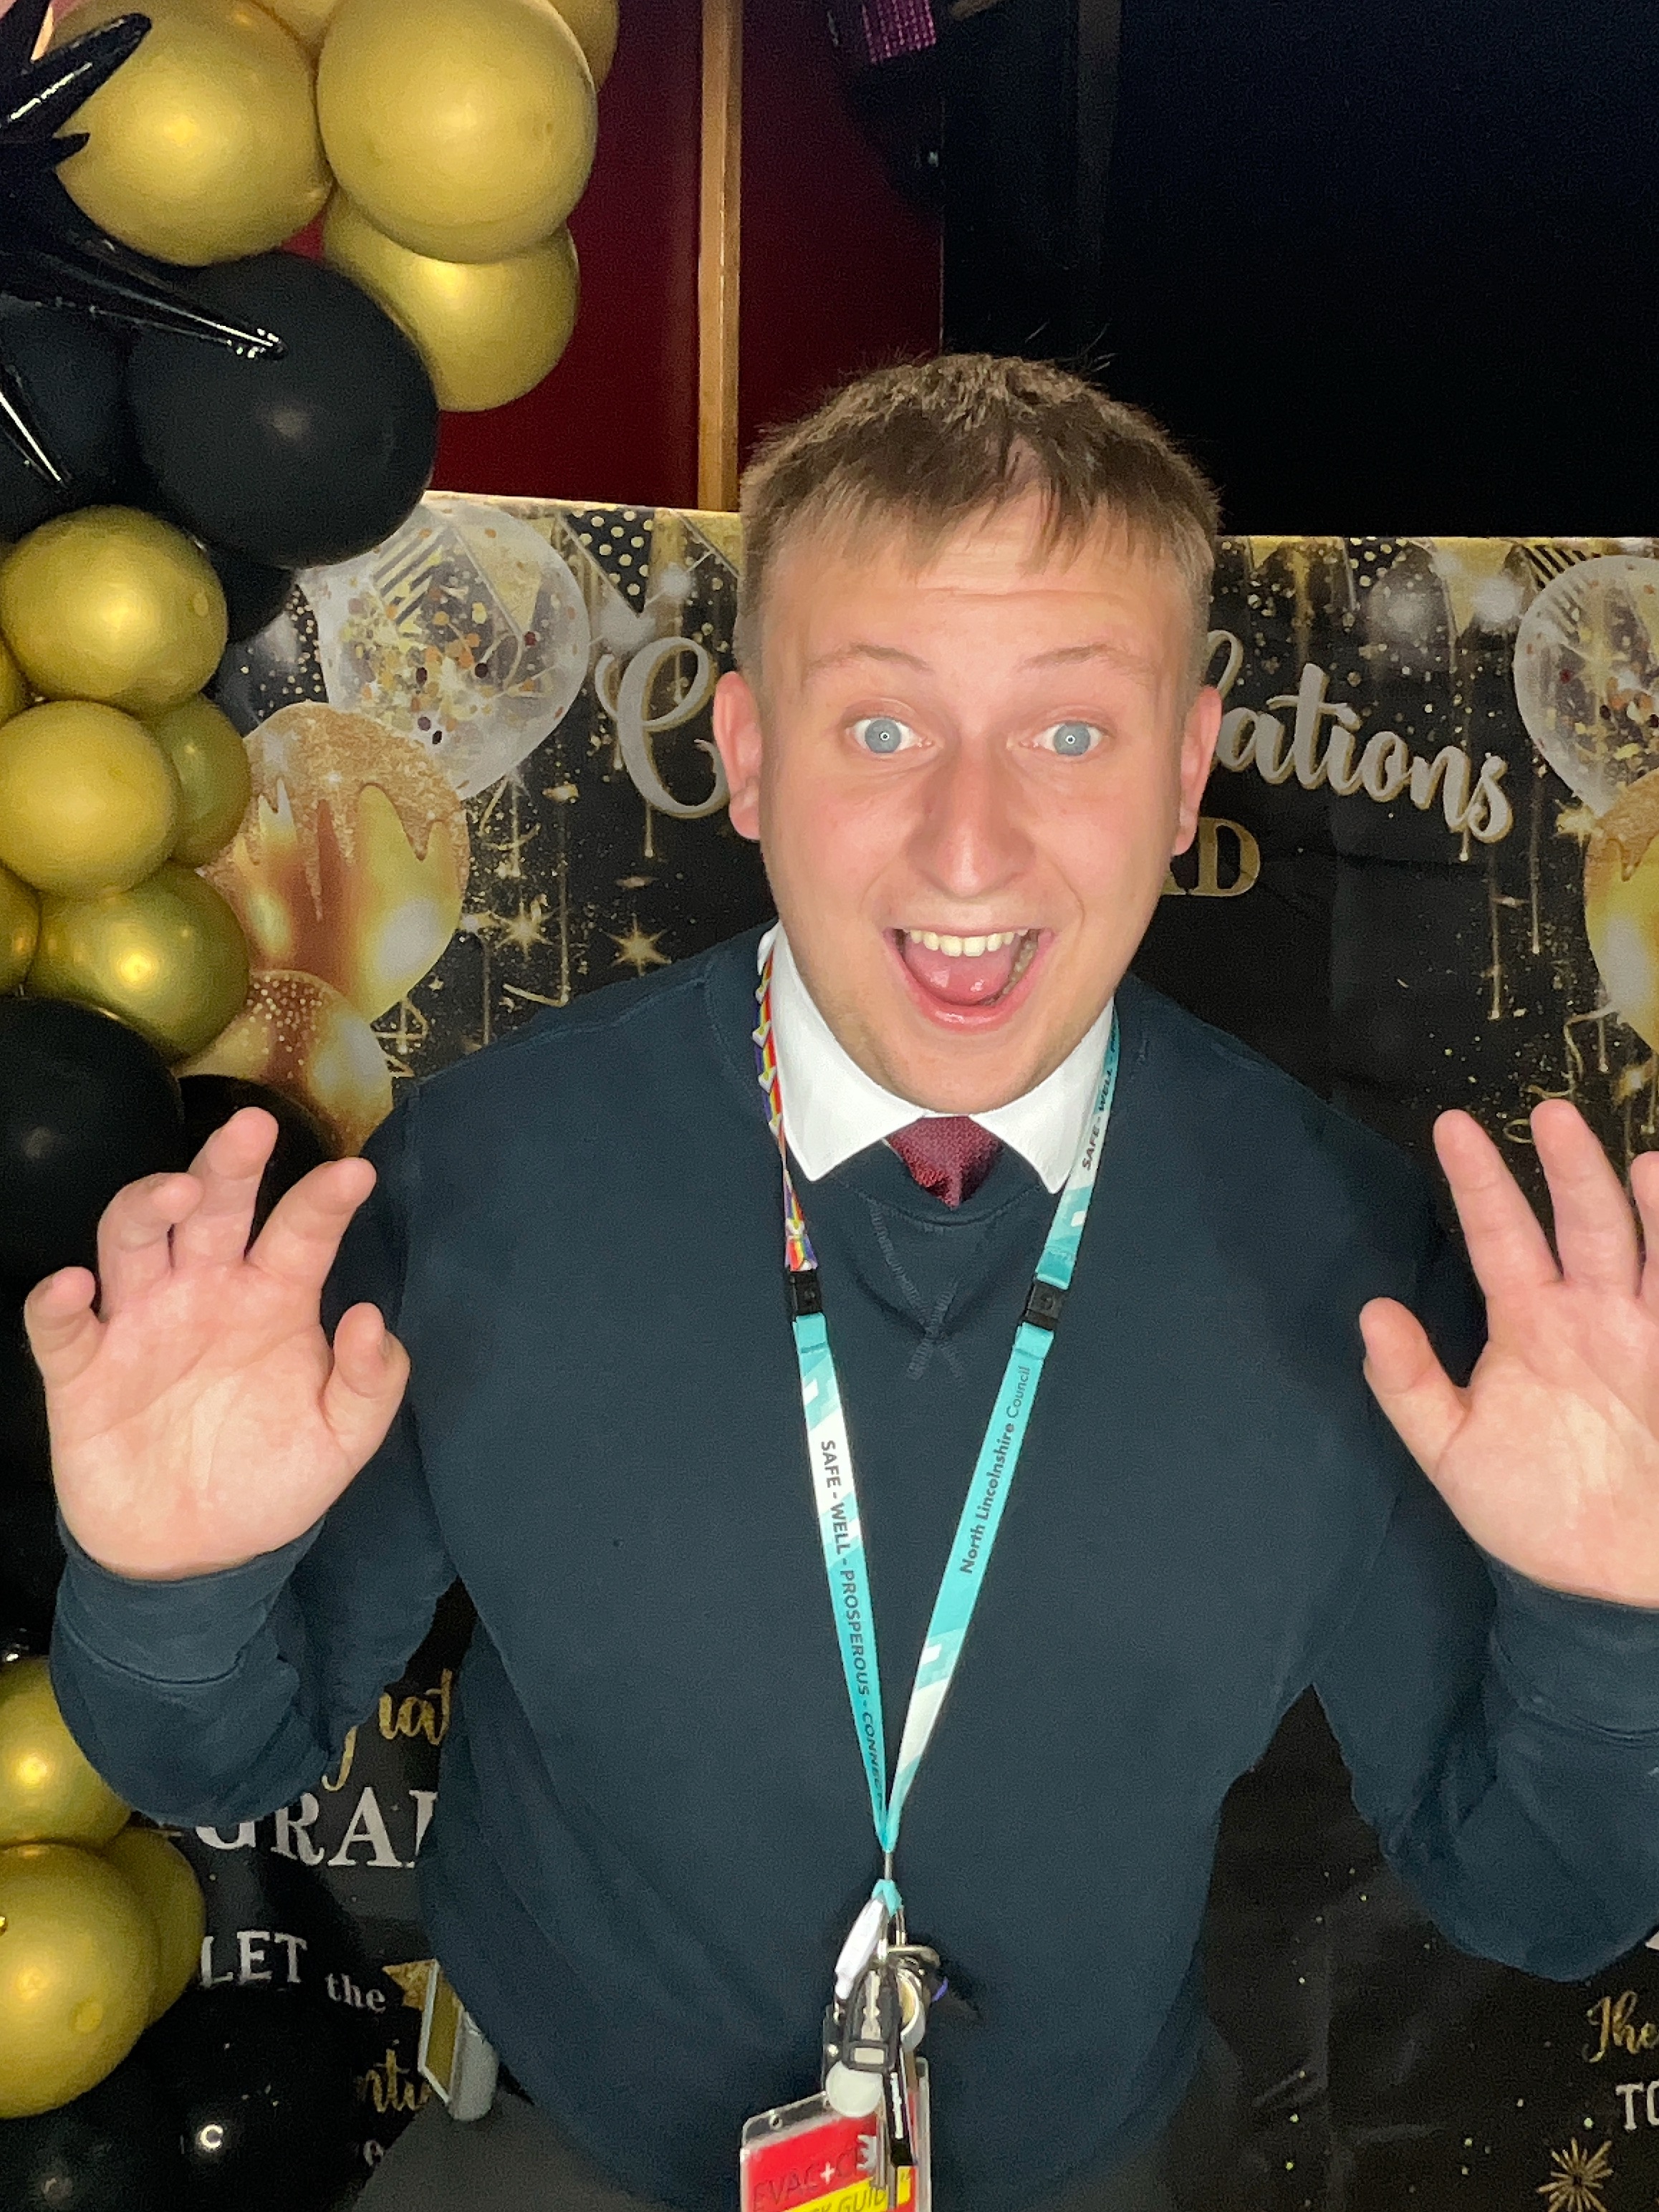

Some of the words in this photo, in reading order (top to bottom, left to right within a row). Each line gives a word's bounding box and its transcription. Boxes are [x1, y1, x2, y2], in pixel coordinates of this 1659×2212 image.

[821, 1440, 842, 1489] SAFE
[959, 1523, 986, 1574] North
[976, 1423, 1014, 1520] Lincolnshire
[1006, 1365, 1030, 1419] Council
[830, 1502, 851, 1555] WELL
[840, 1569, 870, 1696] PROSPEROUS
[862, 1712, 883, 1819] CONNECT
[201, 1928, 308, 1989] LET
[324, 1972, 387, 2014] the
[1582, 1990, 1659, 2064] The
